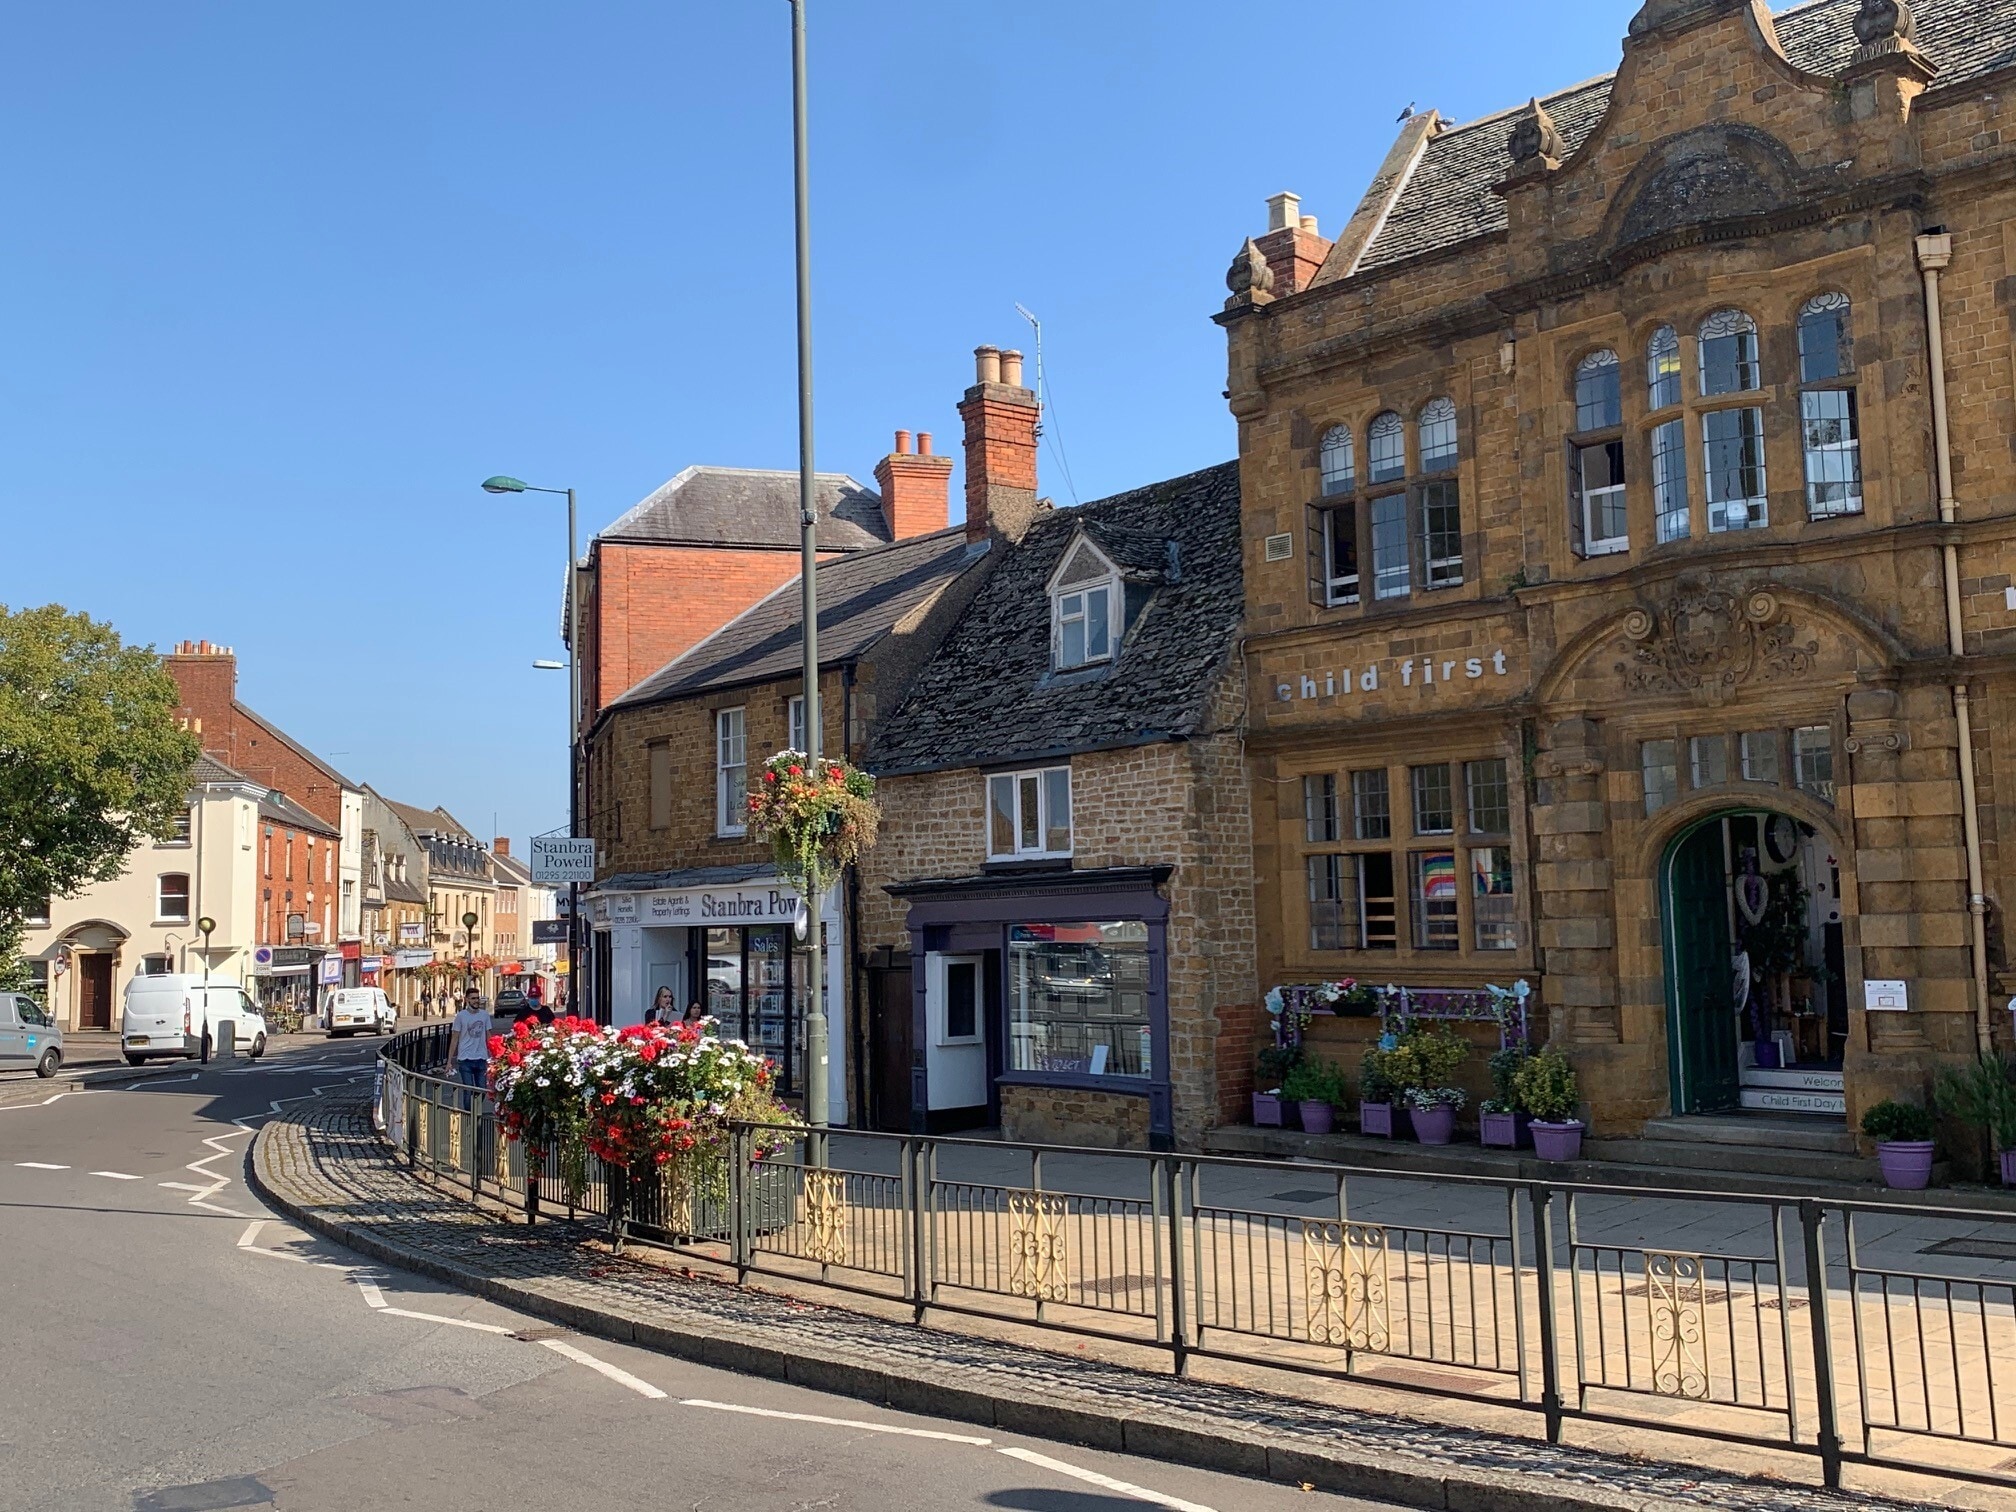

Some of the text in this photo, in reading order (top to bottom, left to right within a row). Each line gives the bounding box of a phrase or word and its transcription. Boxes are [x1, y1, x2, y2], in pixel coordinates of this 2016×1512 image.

[1277, 649, 1507, 702] child first
[533, 841, 593, 854] Stanbra
[545, 854, 592, 868] Powell
[535, 871, 591, 880] 01295 221100
[701, 890, 798, 917] Stanbra Pow
[652, 907, 672, 917] Property
[754, 938, 779, 952] Sales
[1761, 1095, 1789, 1107] Child
[1792, 1097, 1811, 1107] First
[1814, 1097, 1837, 1110] Day
